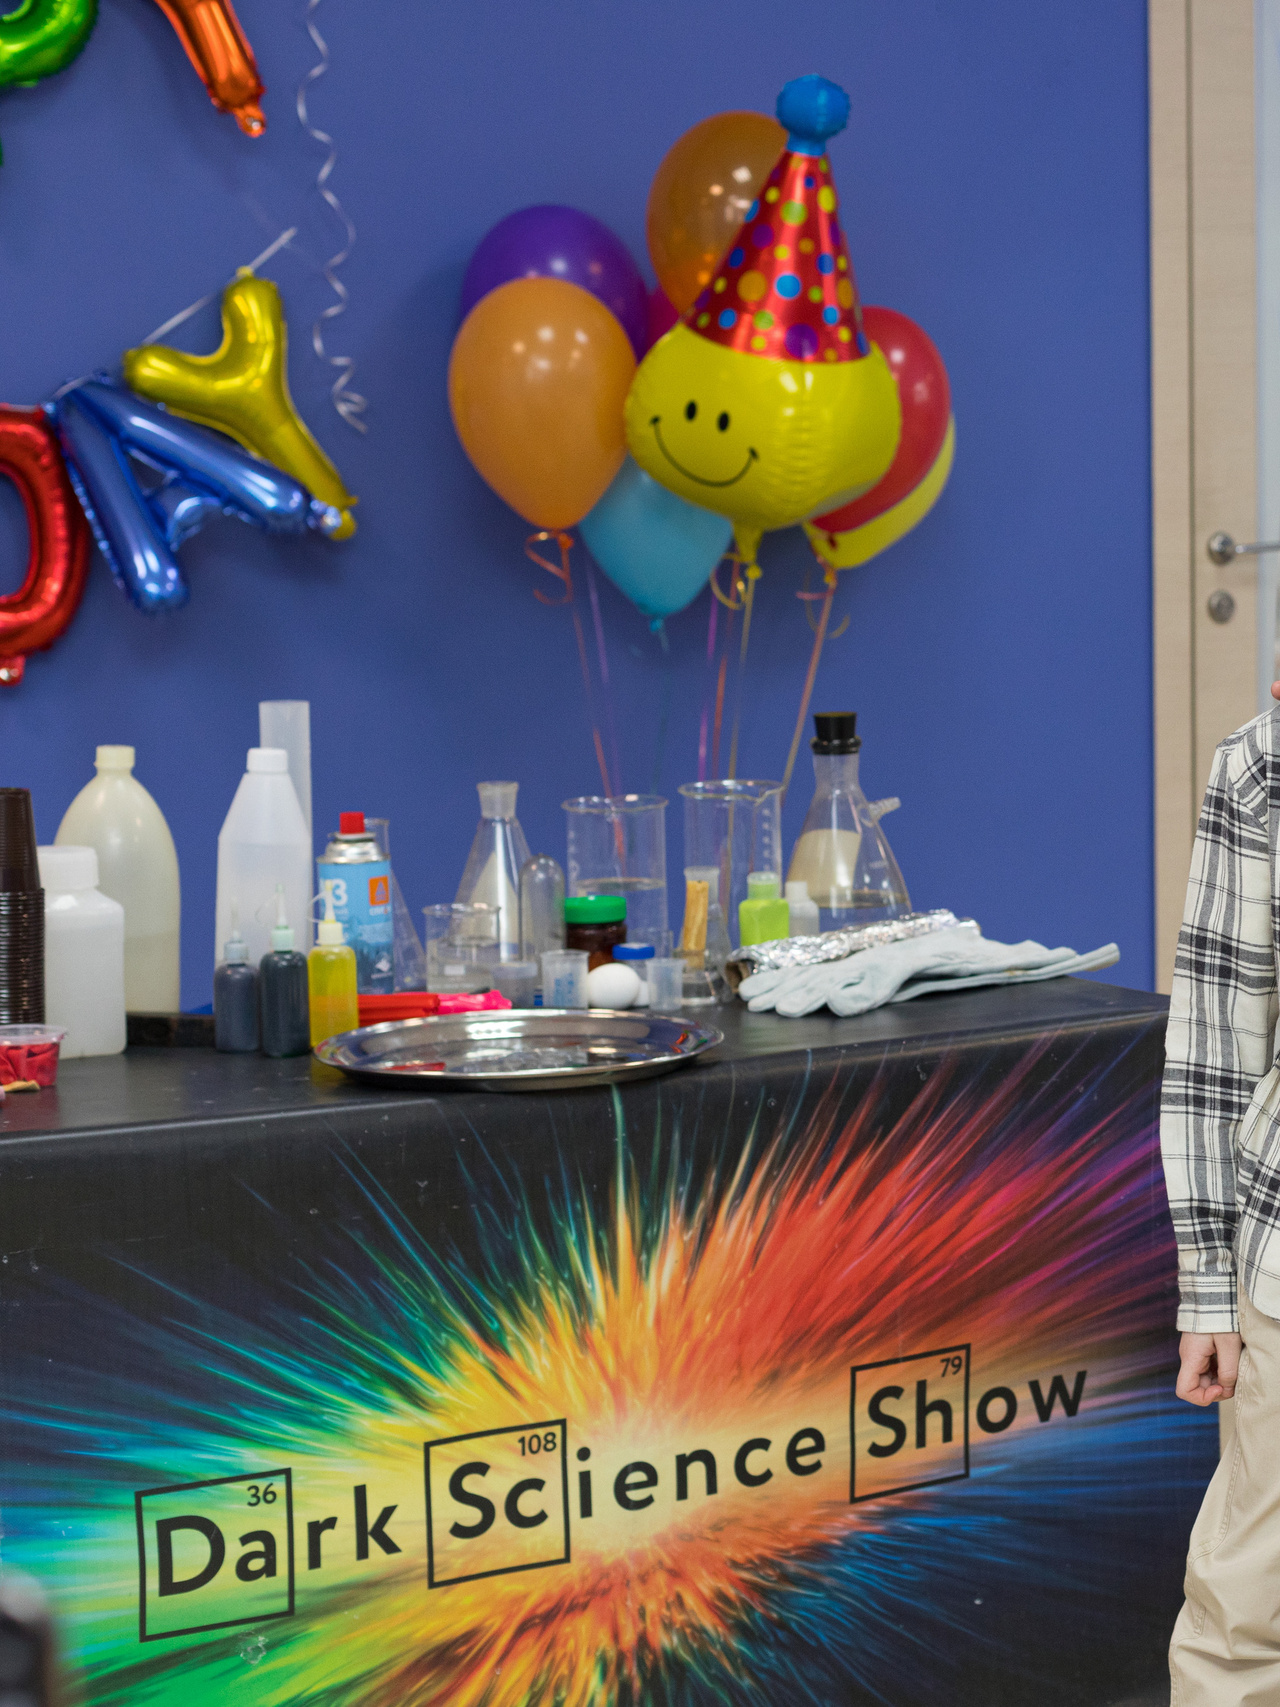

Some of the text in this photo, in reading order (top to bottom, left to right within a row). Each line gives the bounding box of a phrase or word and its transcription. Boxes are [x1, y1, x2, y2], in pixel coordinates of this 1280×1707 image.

[939, 1355, 963, 1378] 79
[517, 1431, 557, 1457] 108
[155, 1369, 1088, 1598] Dark Science Show
[246, 1482, 278, 1507] 36
